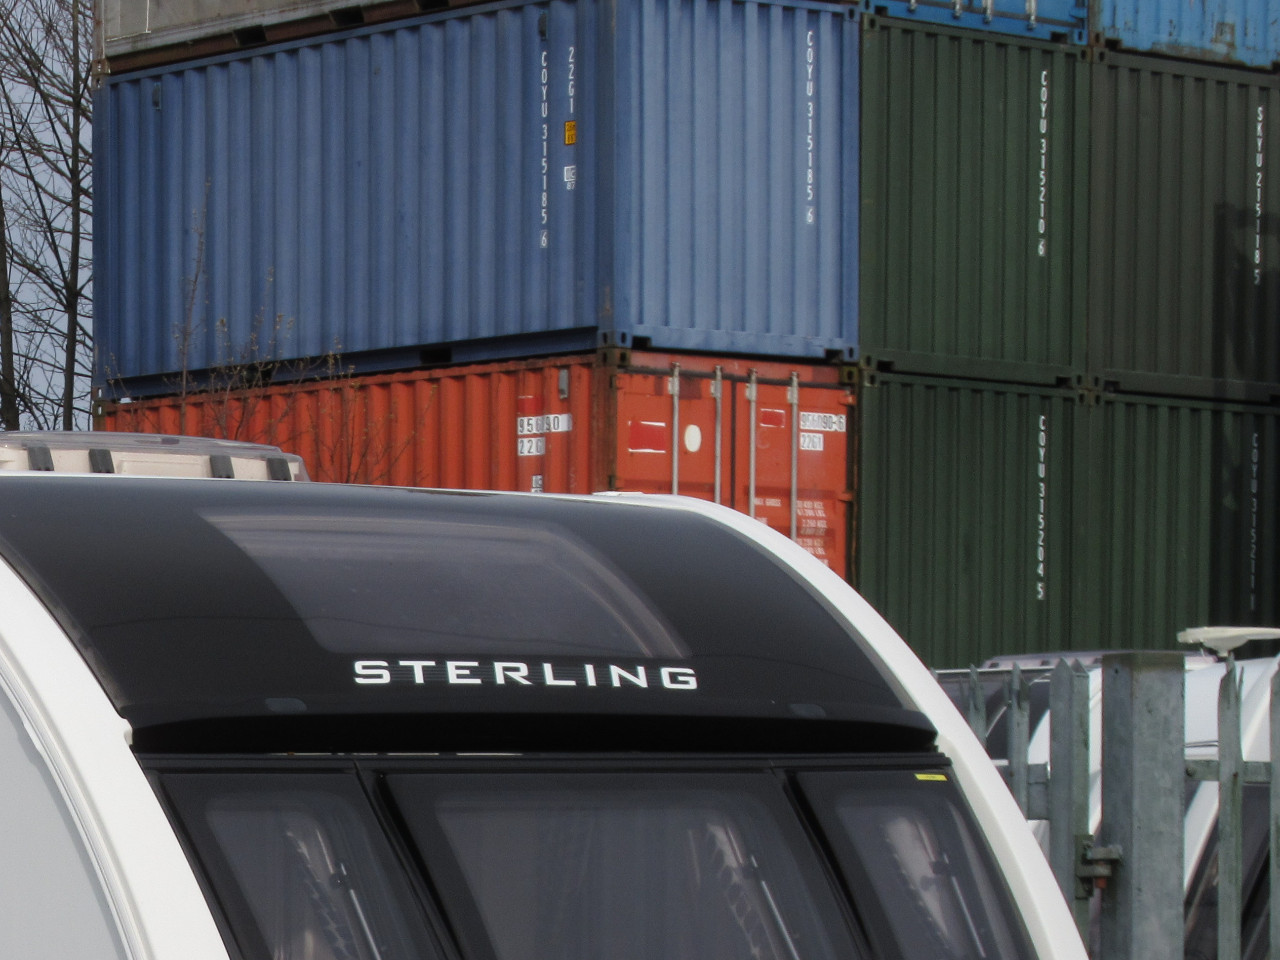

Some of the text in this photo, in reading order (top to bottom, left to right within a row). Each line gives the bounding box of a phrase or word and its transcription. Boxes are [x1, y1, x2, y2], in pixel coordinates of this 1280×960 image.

[806, 31, 814, 97] COYU
[806, 101, 814, 201] 315185
[353, 659, 698, 690] STERLING
